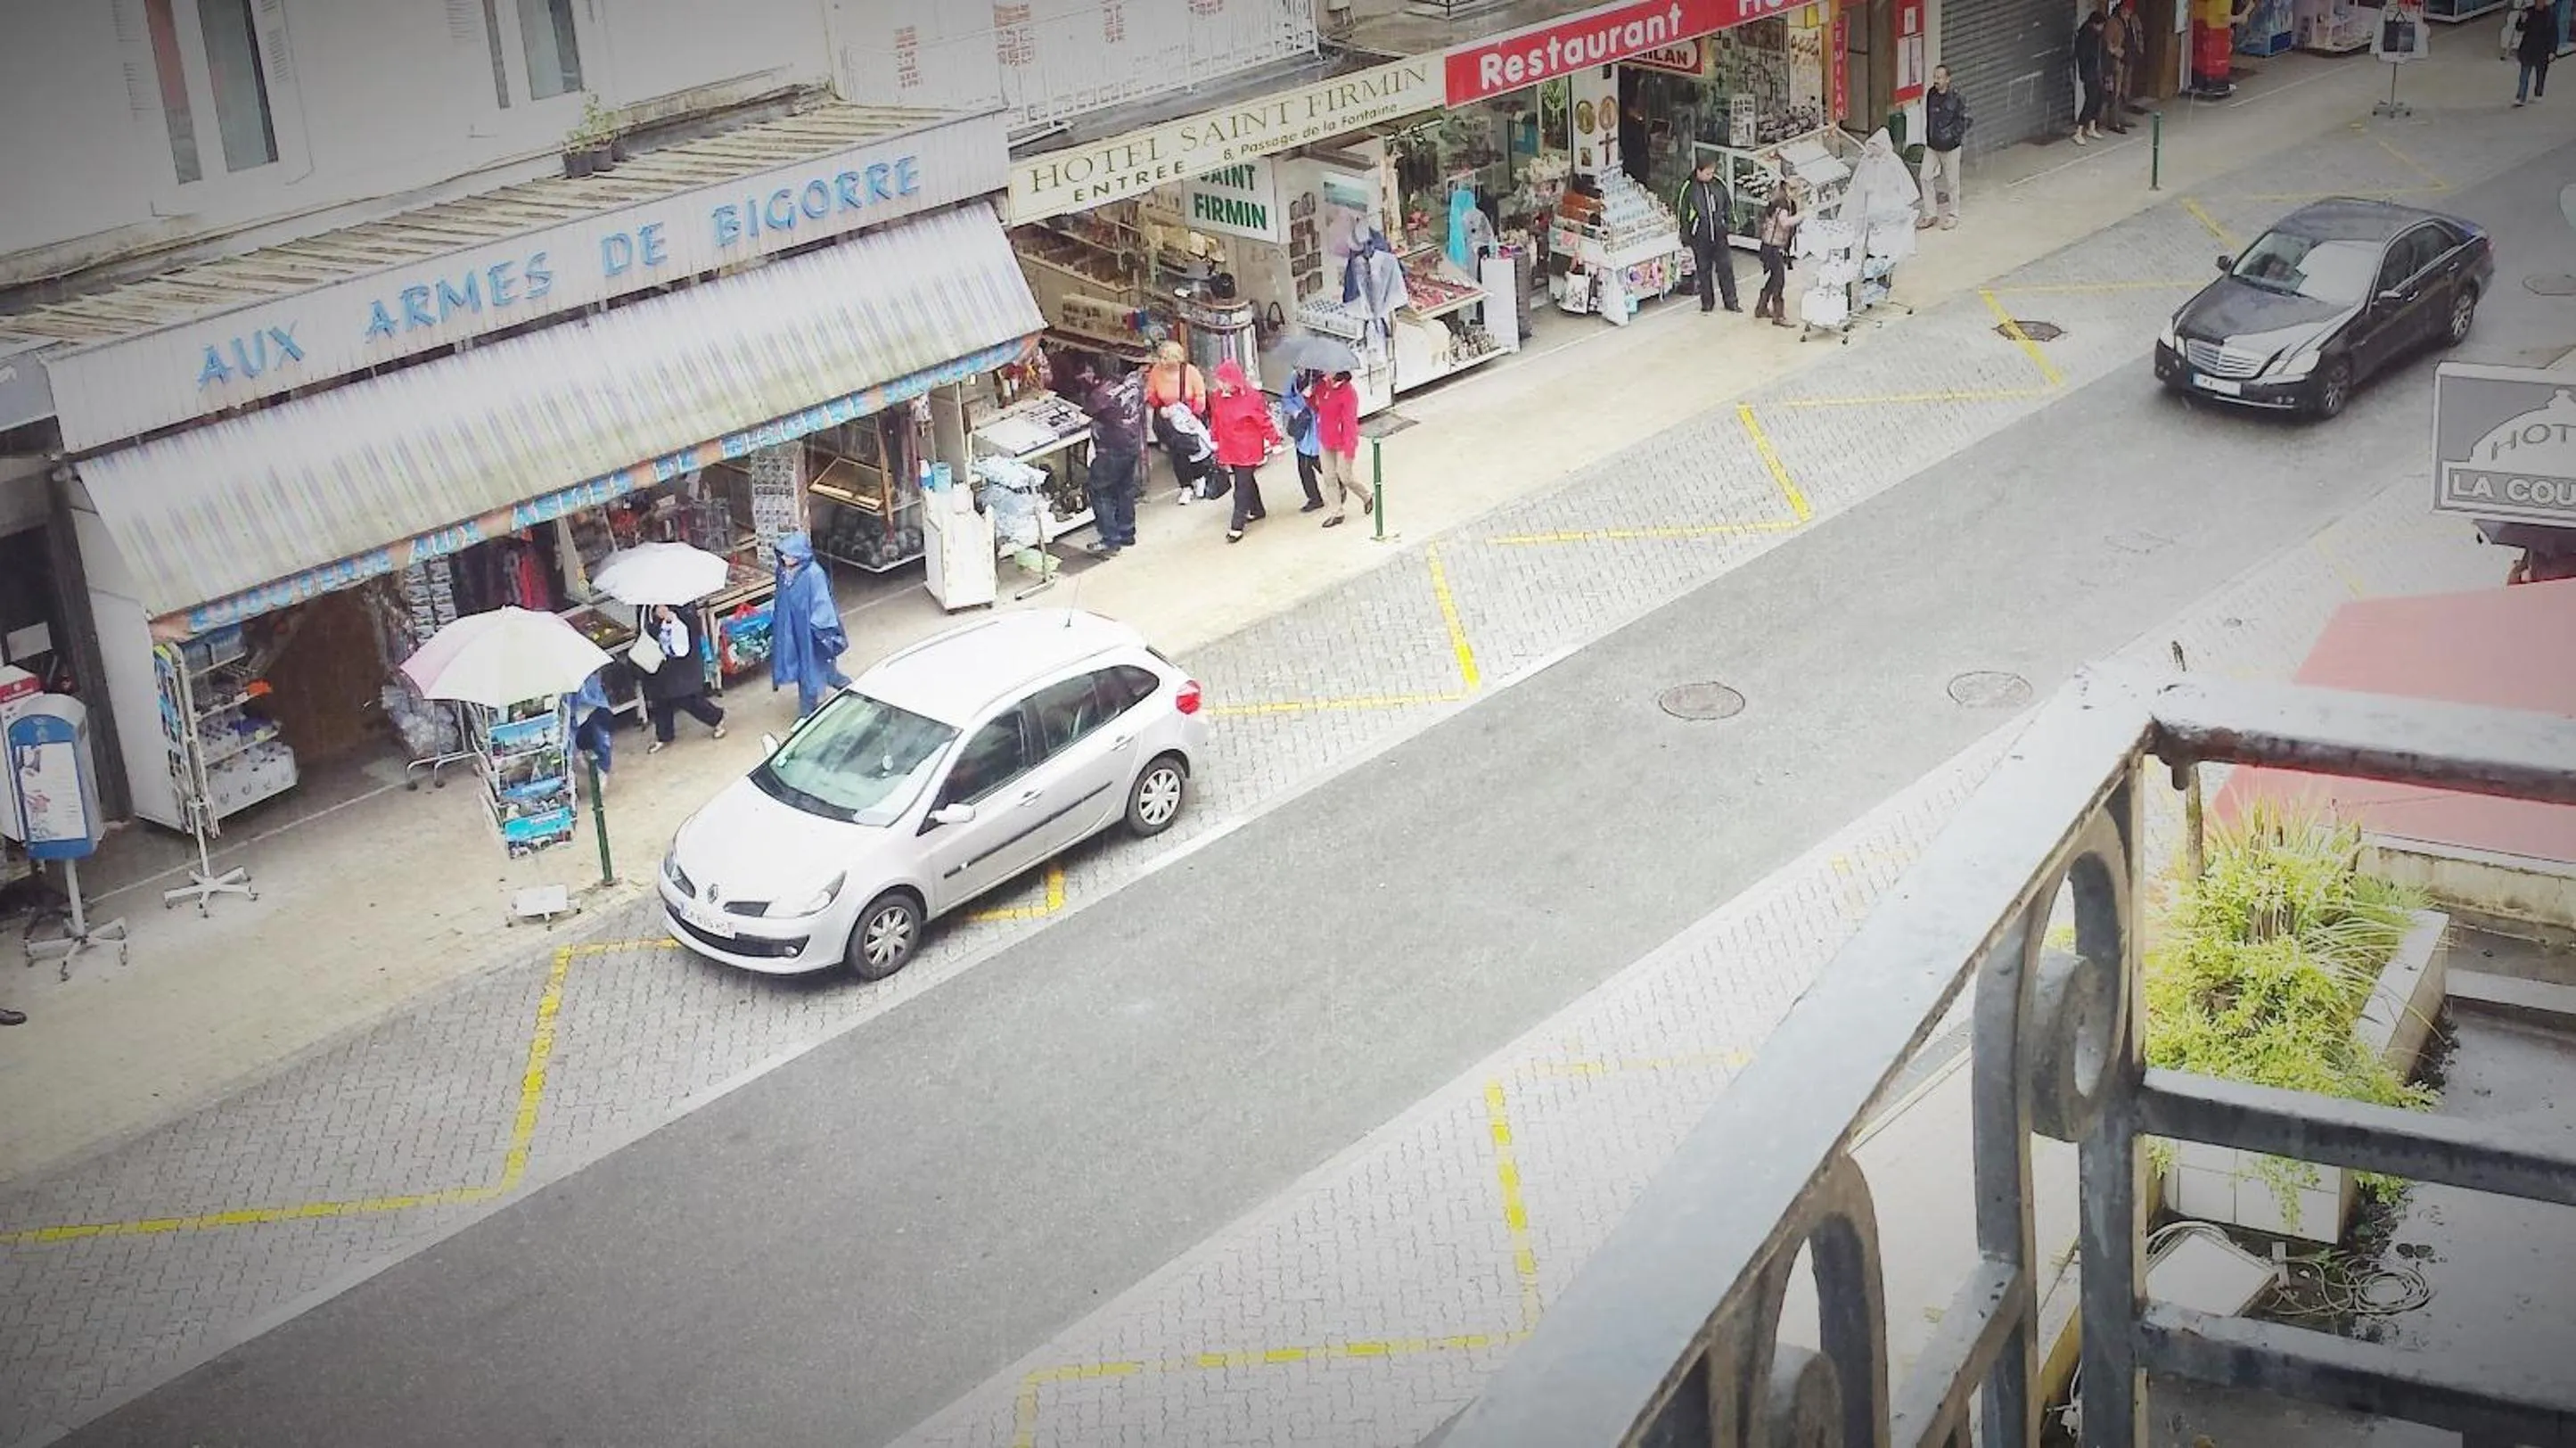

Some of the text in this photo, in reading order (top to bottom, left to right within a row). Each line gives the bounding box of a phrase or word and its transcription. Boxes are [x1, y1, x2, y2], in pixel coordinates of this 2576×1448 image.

[1480, 2, 1683, 91] Restaurant
[1030, 64, 1427, 193] HOTEL SAINT FIRMIN
[1240, 133, 1297, 156] Passage
[1302, 125, 1320, 139] de
[1323, 119, 1337, 133] la
[1341, 103, 1398, 127] Fontaine
[1073, 160, 1185, 202] ENTREE
[1199, 164, 1256, 192] AINT
[1194, 192, 1267, 231] FIRMIN
[197, 154, 922, 392] AUX ARMES DE BIGORRE
[2453, 473, 2494, 498] LA
